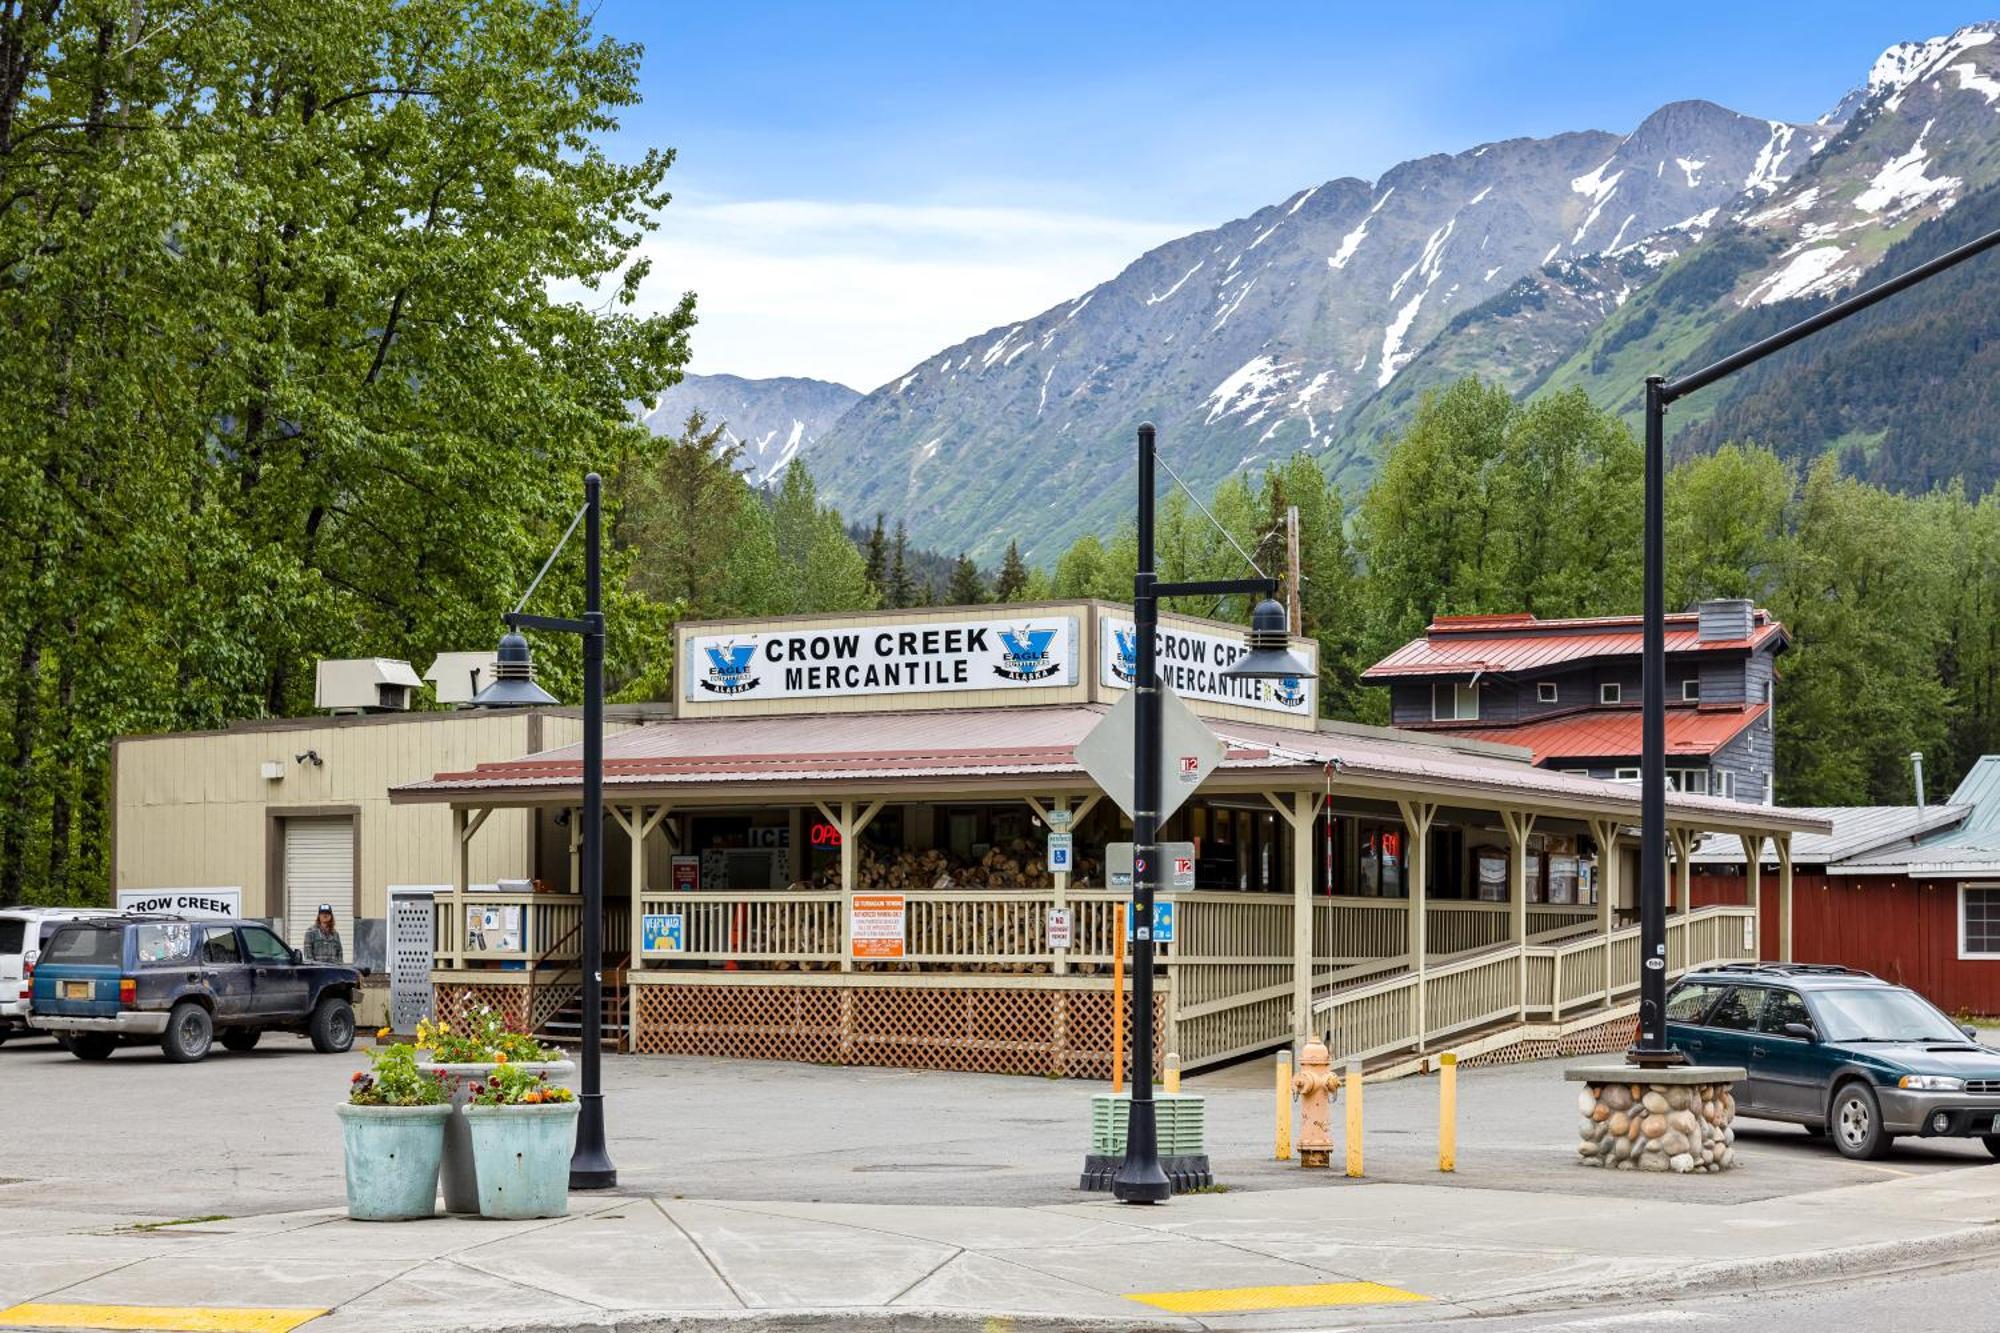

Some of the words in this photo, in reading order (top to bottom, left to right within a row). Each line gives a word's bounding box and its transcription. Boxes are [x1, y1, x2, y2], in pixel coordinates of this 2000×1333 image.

[766, 635, 860, 662] CROW
[875, 628, 989, 657] CREEK
[1155, 633, 1206, 663] CROW
[1003, 651, 1049, 661] EAGLE
[709, 665, 751, 675] EAGLE
[786, 659, 968, 691] MERCANTILE
[1008, 669, 1049, 681] ALASKA
[714, 682, 750, 694] ALASKA
[1163, 664, 1262, 701] MERCANTILE
[752, 829, 789, 847] ICE
[811, 824, 842, 845] OPE
[177, 897, 231, 915] CREEK
[1056, 916, 1064, 924] NO
